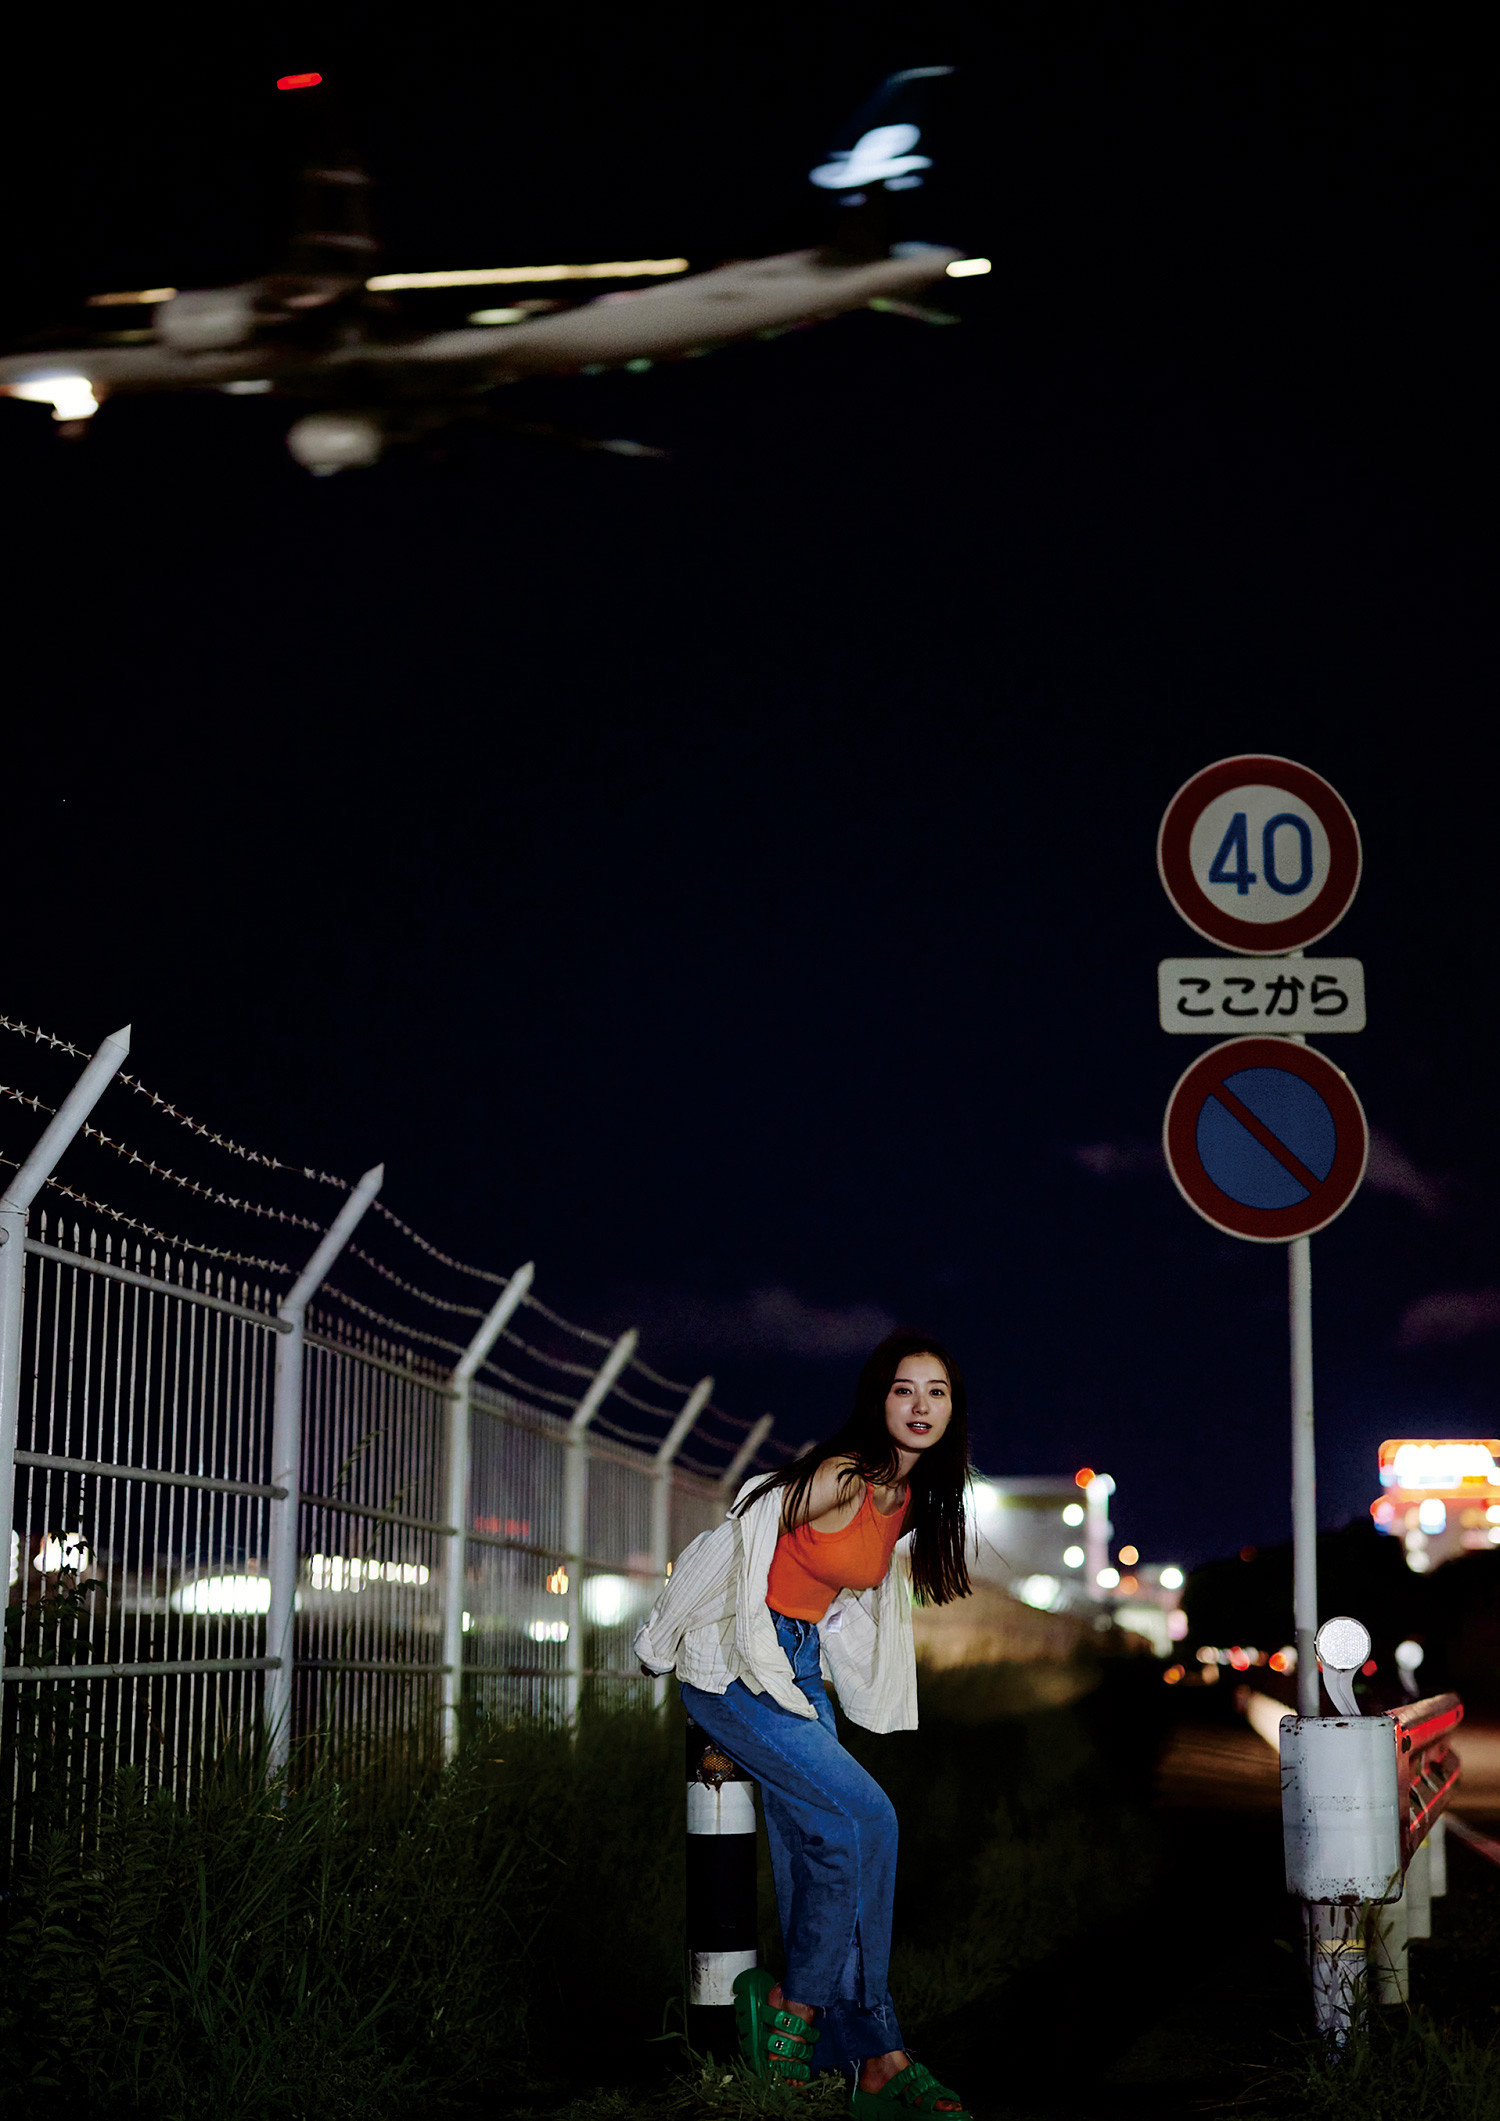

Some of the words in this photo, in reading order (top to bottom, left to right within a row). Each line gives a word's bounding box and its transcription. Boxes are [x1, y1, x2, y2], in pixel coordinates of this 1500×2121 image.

[1209, 812, 1312, 895] 40
[1177, 975, 1348, 1016] ここから
